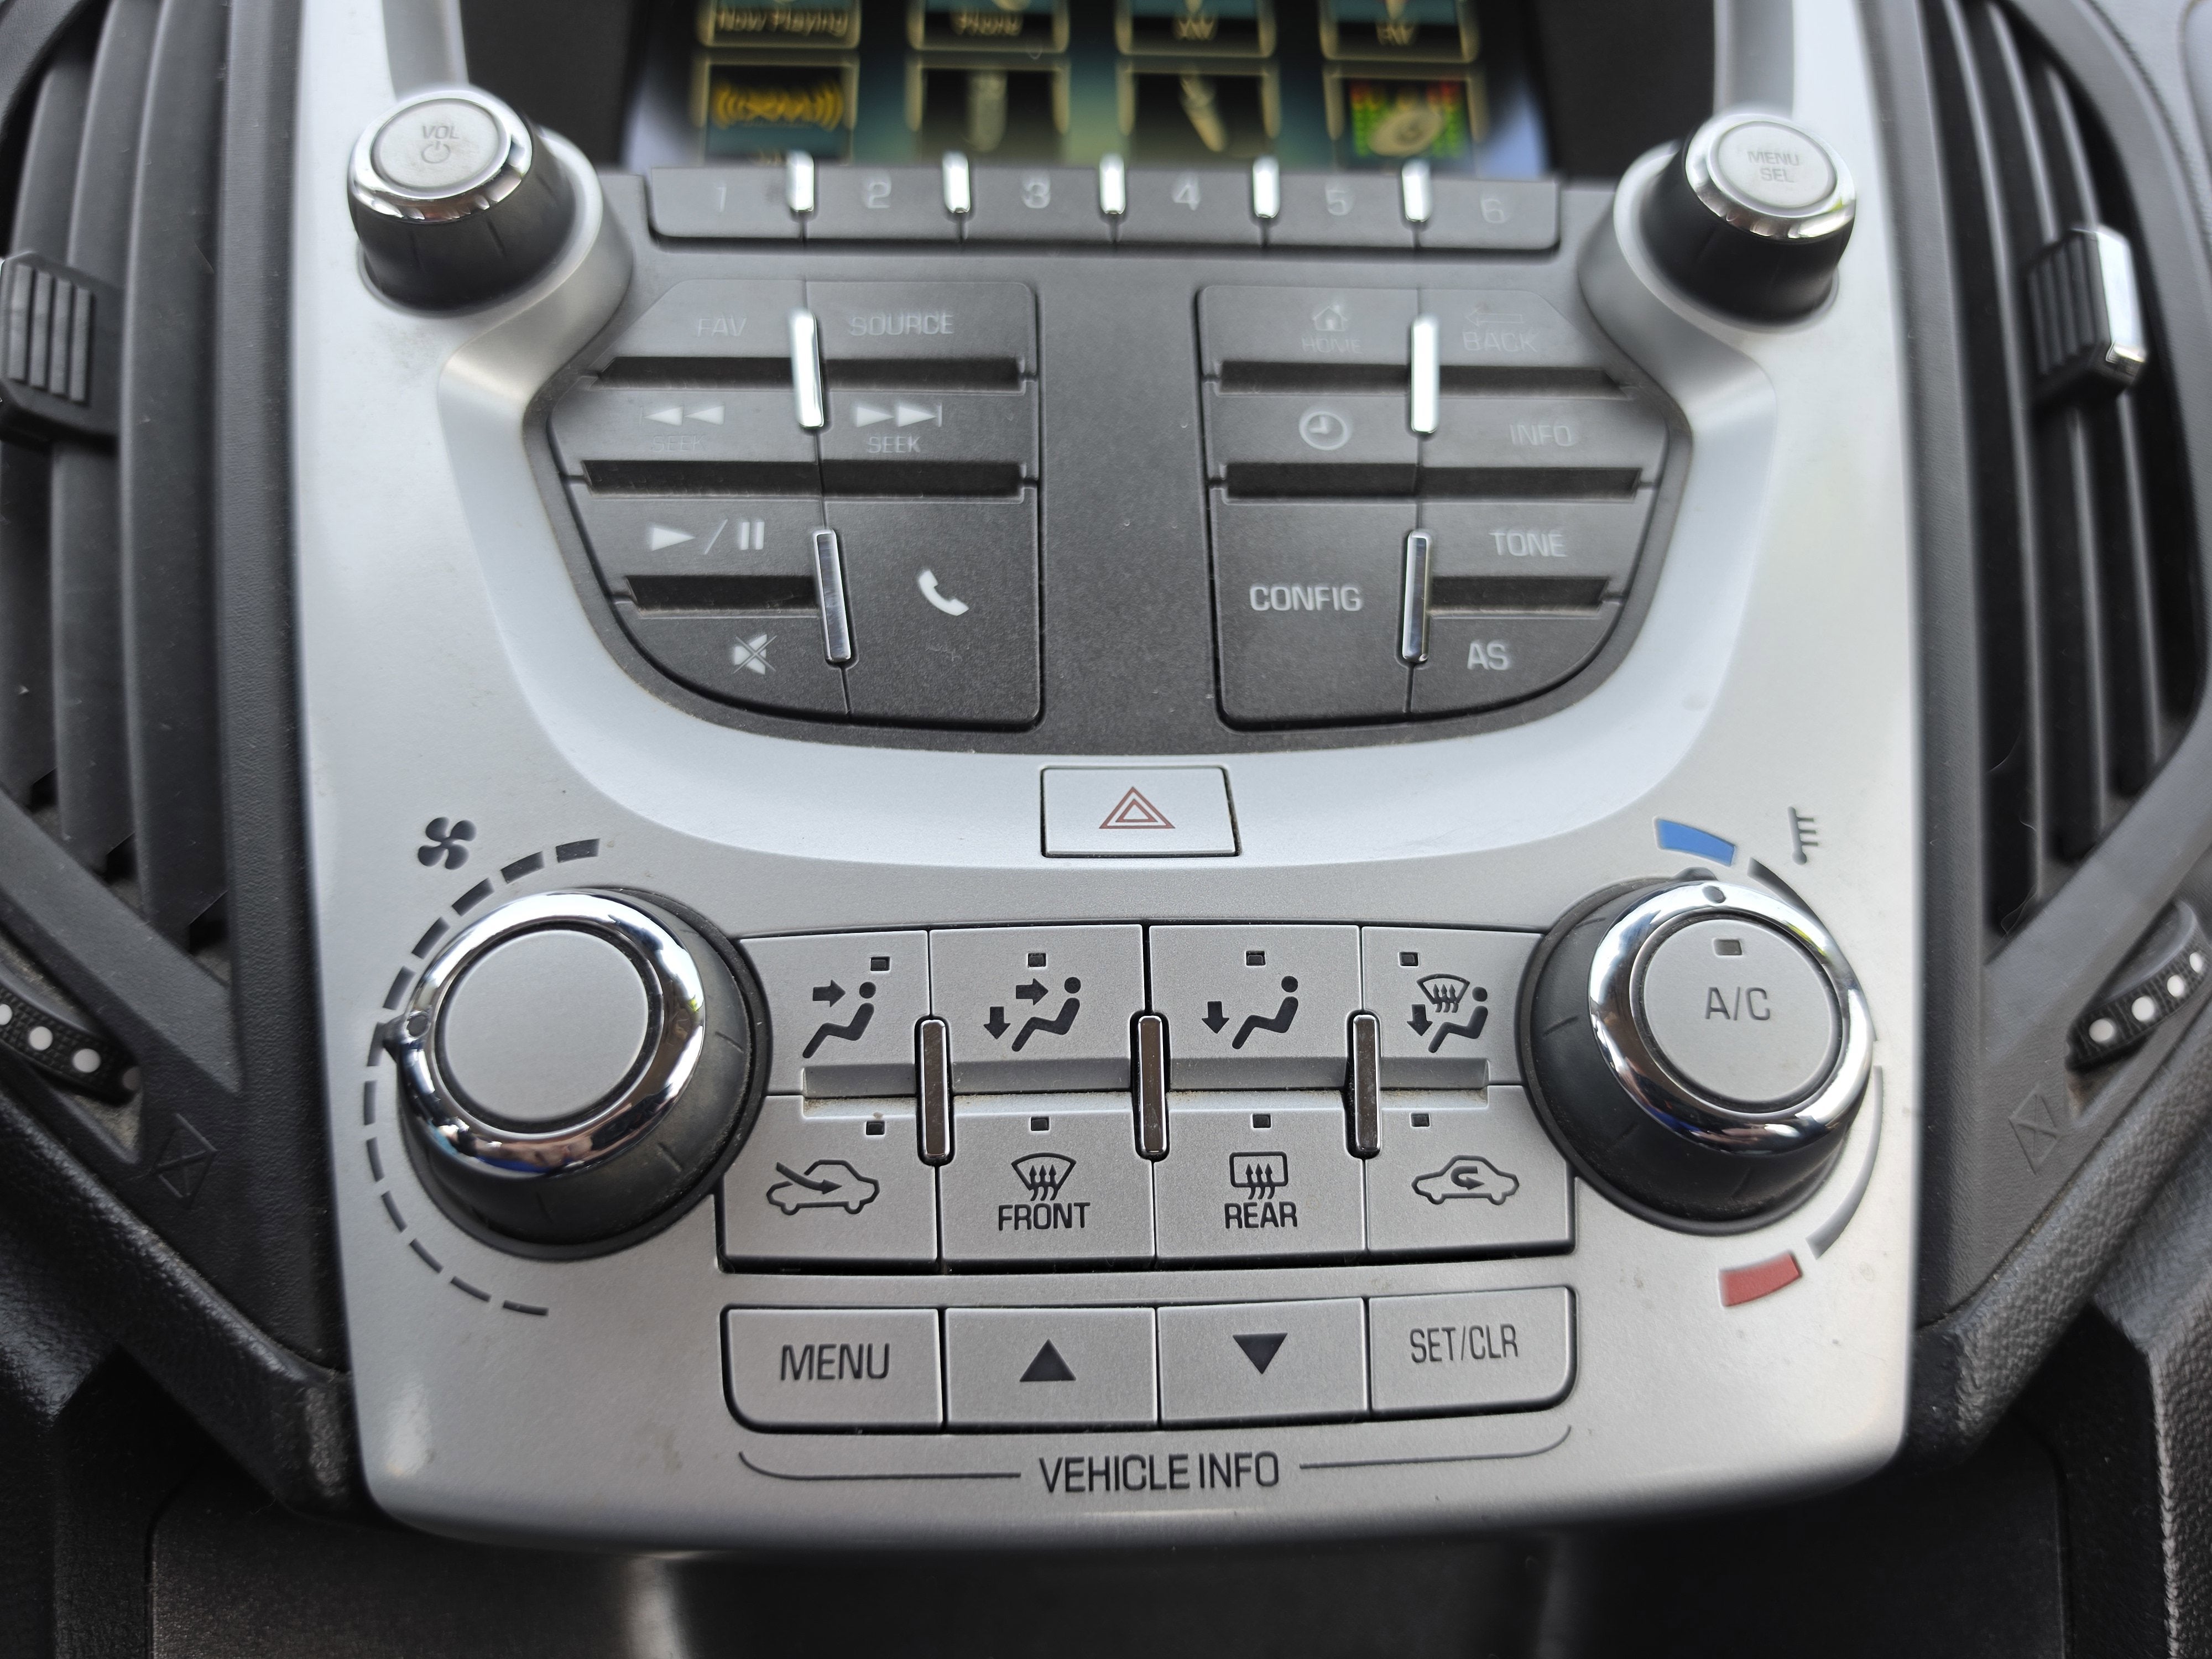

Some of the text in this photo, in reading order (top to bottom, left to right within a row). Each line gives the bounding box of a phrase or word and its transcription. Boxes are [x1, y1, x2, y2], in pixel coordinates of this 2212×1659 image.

[422, 125, 461, 140] VOL
[1747, 151, 1800, 166] MENU
[1759, 168, 1794, 183] SEL
[716, 184, 726, 212] 1
[867, 179, 891, 208] 2
[1022, 178, 1051, 209] 3
[1173, 180, 1199, 211] 4
[1327, 185, 1353, 216] 5
[1481, 196, 1509, 223] 6
[697, 317, 747, 337] FAV
[849, 314, 954, 336] SOURCE
[1301, 337, 1361, 354] HOME
[1462, 331, 1538, 353] BACK
[868, 436, 921, 454] SEEK
[1510, 423, 1574, 447] INFO
[1489, 530, 1568, 557] TONE
[1249, 585, 1363, 612] CONFIG
[1467, 641, 1511, 671] AS
[1704, 986, 1771, 1021] A/C
[998, 1202, 1091, 1231] FRONT
[1224, 1201, 1298, 1229] REAR
[1409, 1323, 1519, 1363] SET/CLR
[780, 1343, 890, 1381] MENU
[1038, 1450, 1280, 1494] VEHICLE INFO
